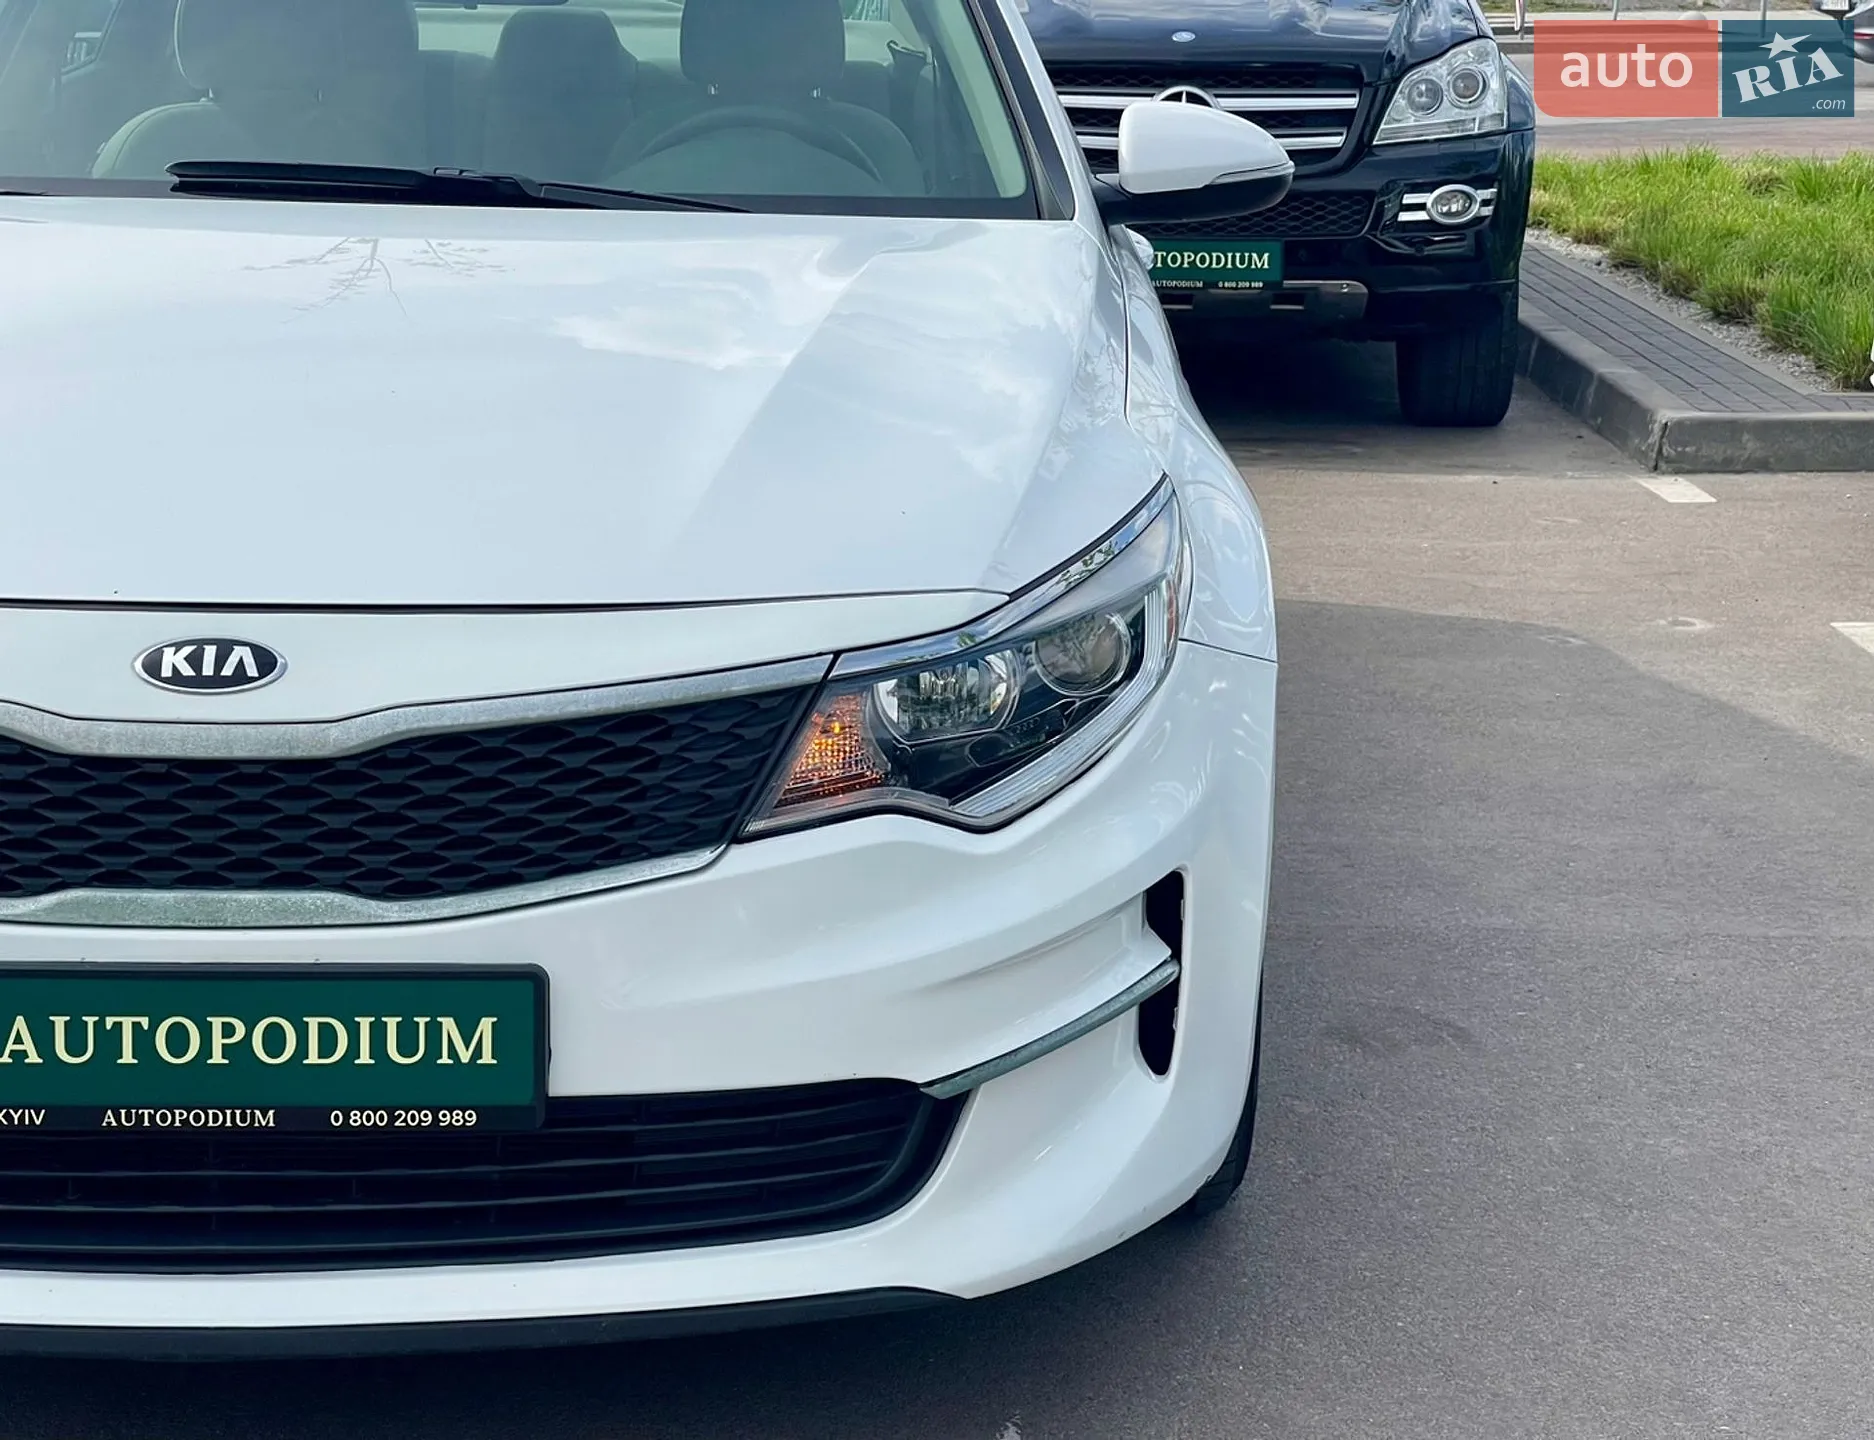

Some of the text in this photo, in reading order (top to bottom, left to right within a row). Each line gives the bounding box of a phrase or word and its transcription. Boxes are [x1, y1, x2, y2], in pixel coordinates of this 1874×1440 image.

[1154, 251, 1270, 269] TOPODIUM
[160, 645, 260, 678] KIA
[0, 1015, 498, 1065] AUTOPODIUM
[101, 1108, 276, 1127] AUTOPODIUM
[330, 1110, 344, 1127] 0
[349, 1110, 388, 1127] 800
[393, 1110, 433, 1127] 209
[437, 1109, 477, 1127] 989
